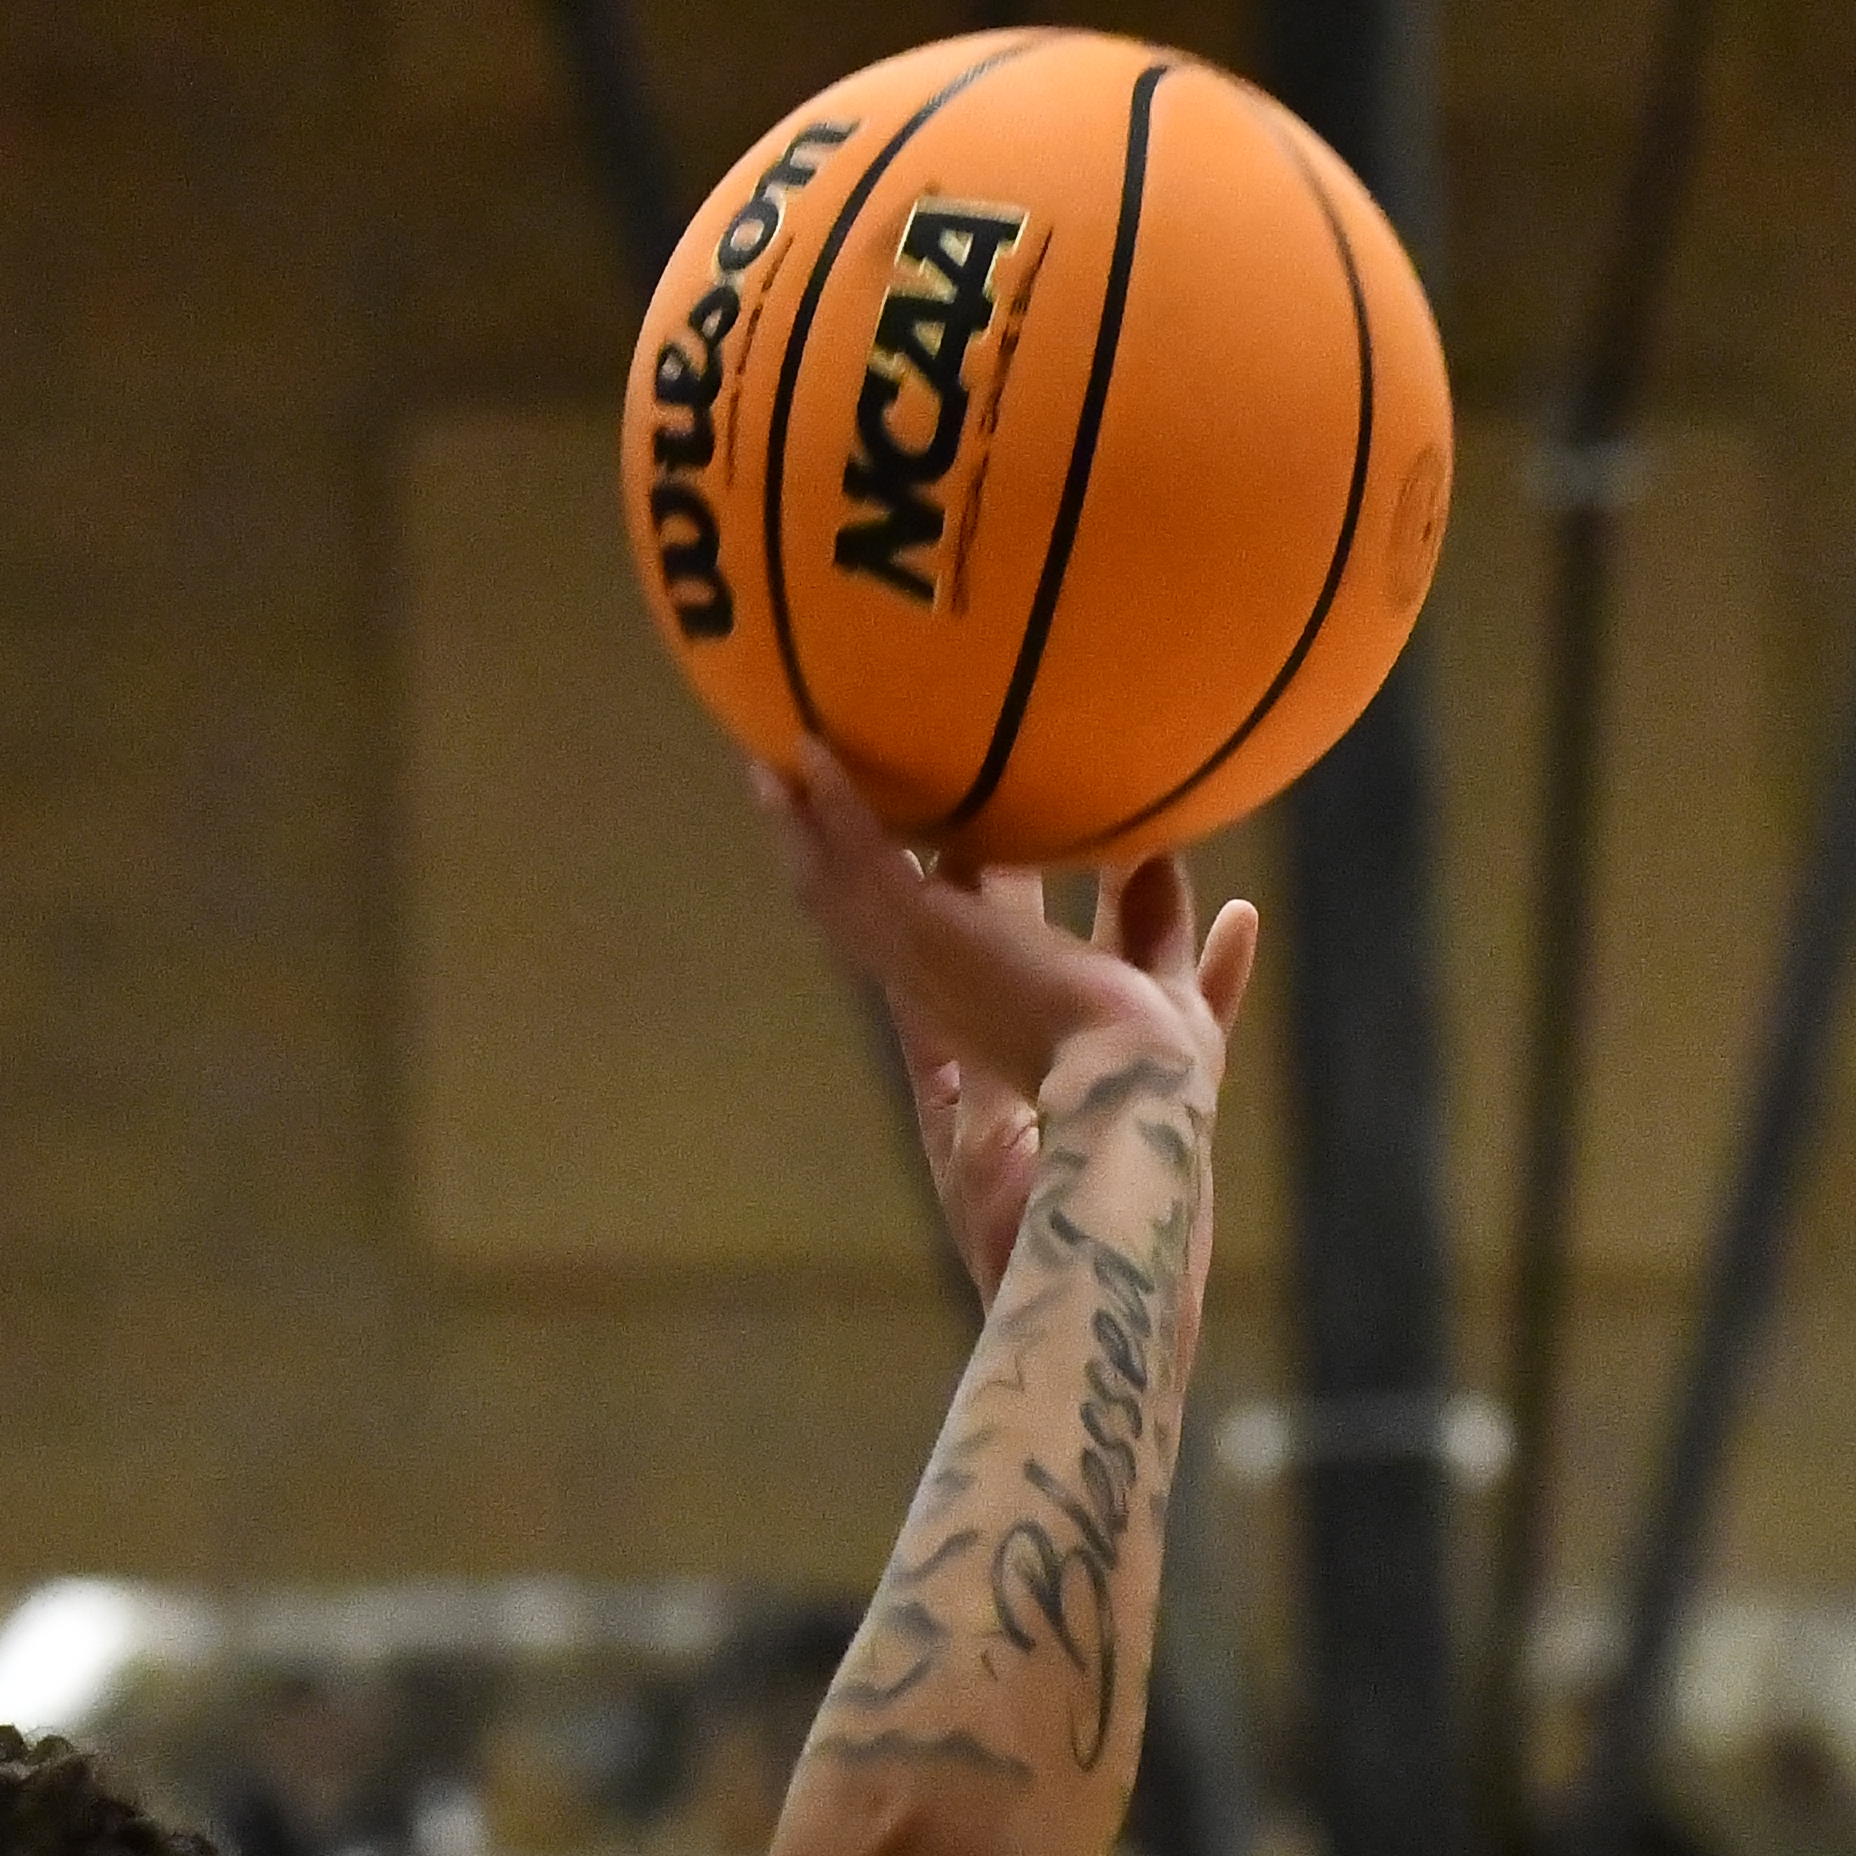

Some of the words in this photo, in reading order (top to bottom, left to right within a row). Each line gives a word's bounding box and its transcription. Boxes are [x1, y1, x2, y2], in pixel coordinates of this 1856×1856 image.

[650, 118, 862, 641] Wilson
[832, 195, 1031, 618] NCAA
[992, 1208, 1155, 1772] Blessed
